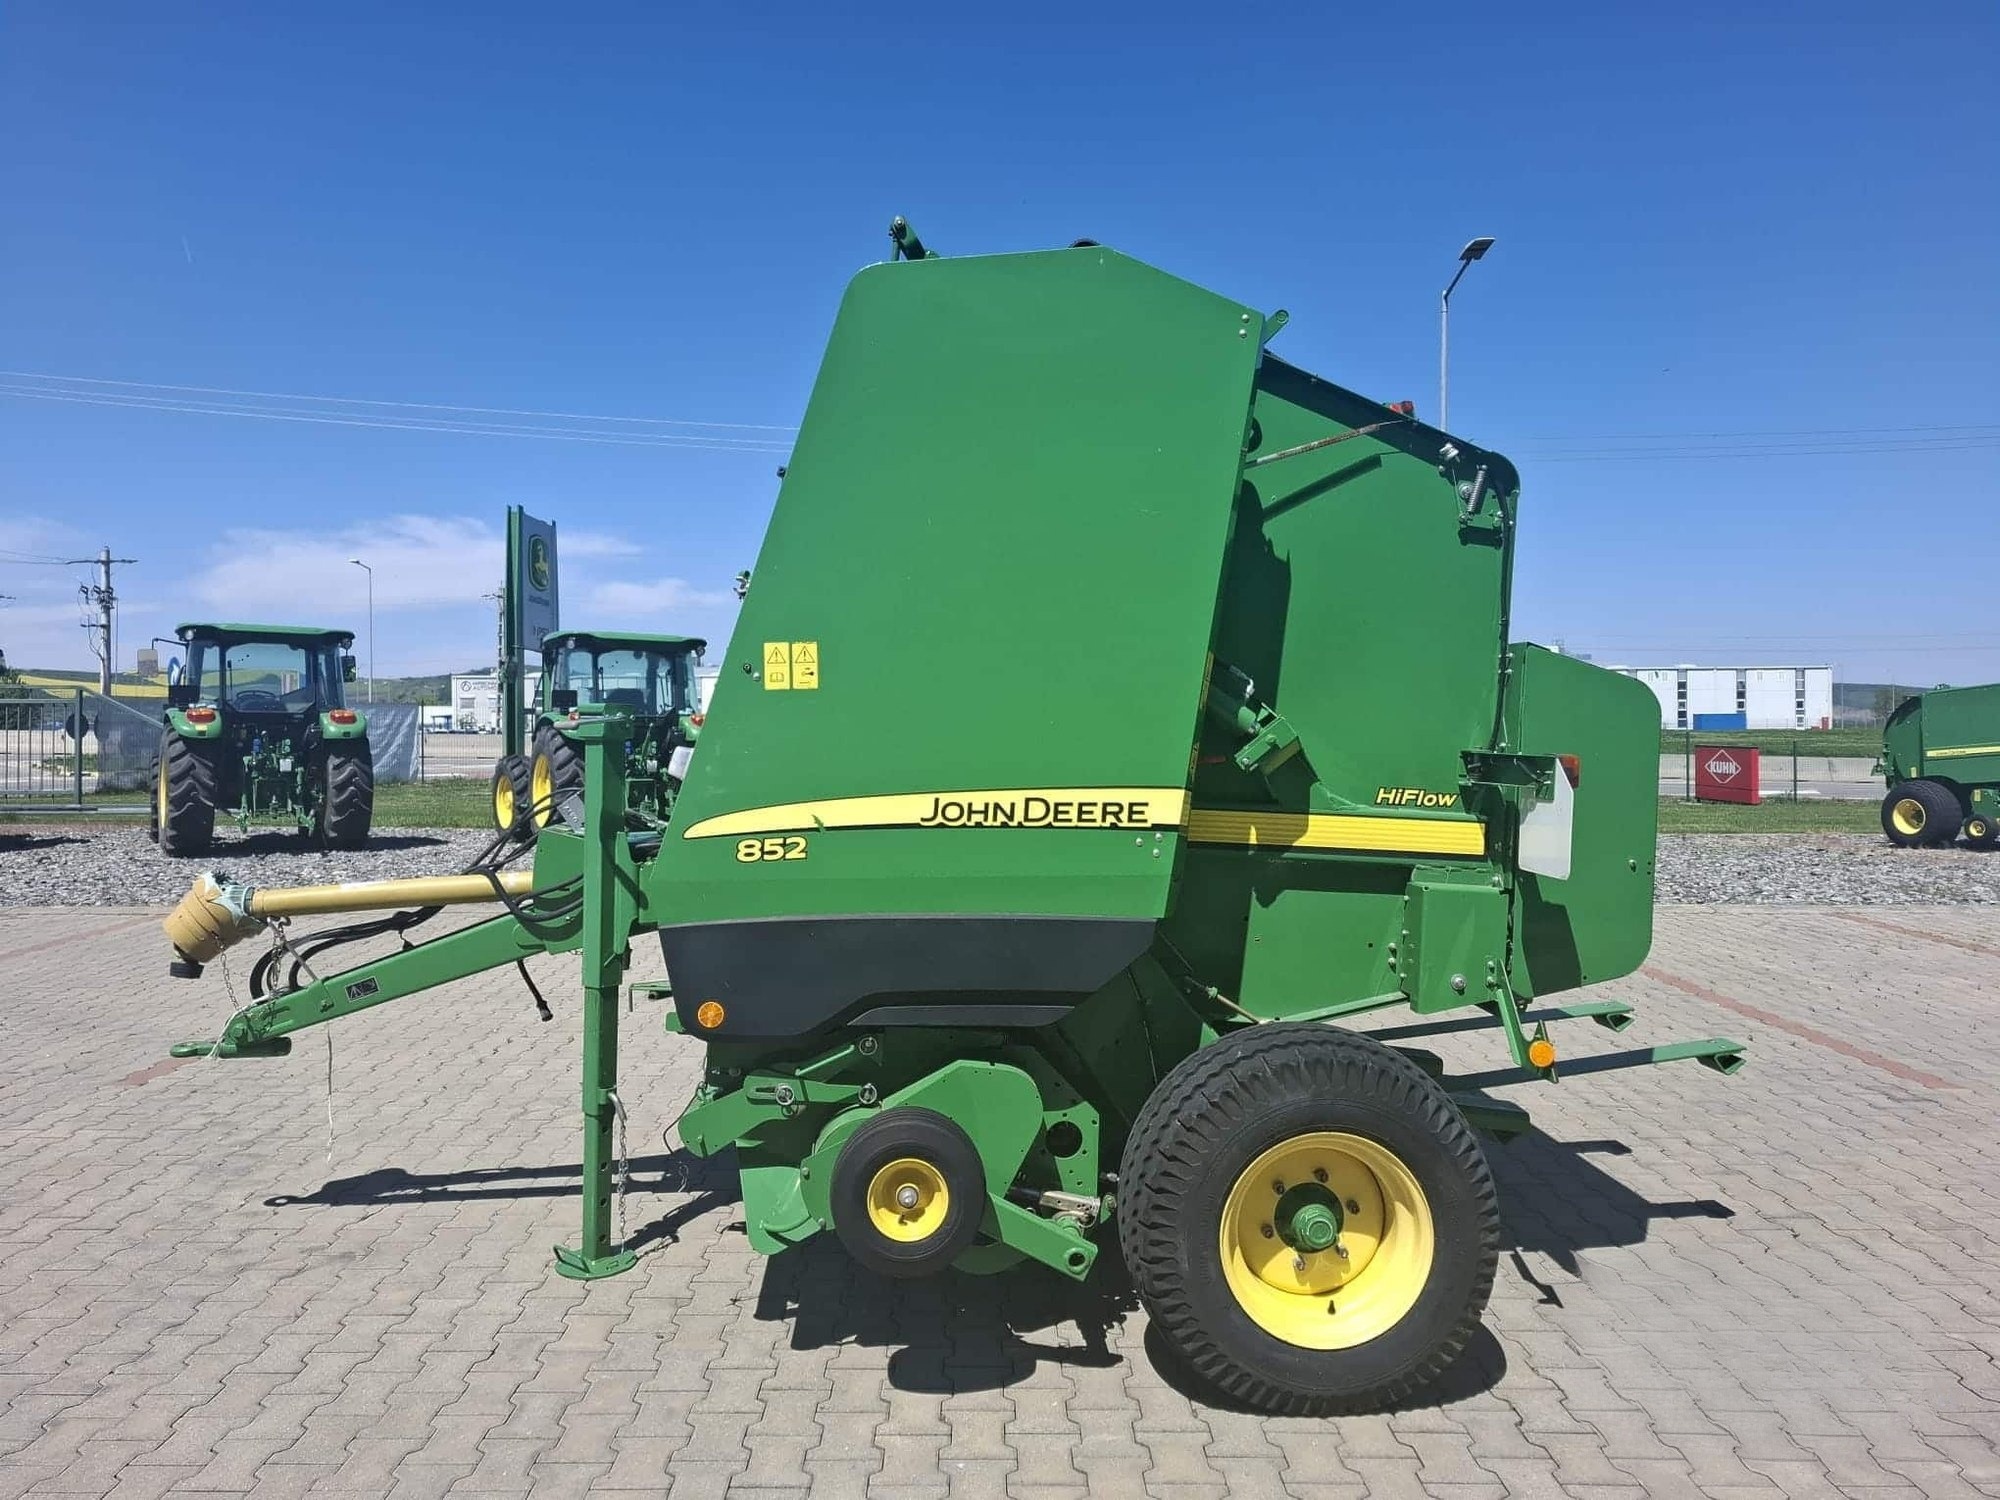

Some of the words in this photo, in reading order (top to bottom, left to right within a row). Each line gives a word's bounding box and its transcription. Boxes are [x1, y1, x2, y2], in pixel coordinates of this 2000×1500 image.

[1710, 761, 1736, 775] KUHN
[1375, 786, 1458, 808] HiFlow
[920, 797, 1016, 823] JOHN
[1023, 797, 1149, 824] DEERE
[736, 836, 808, 863] 852
